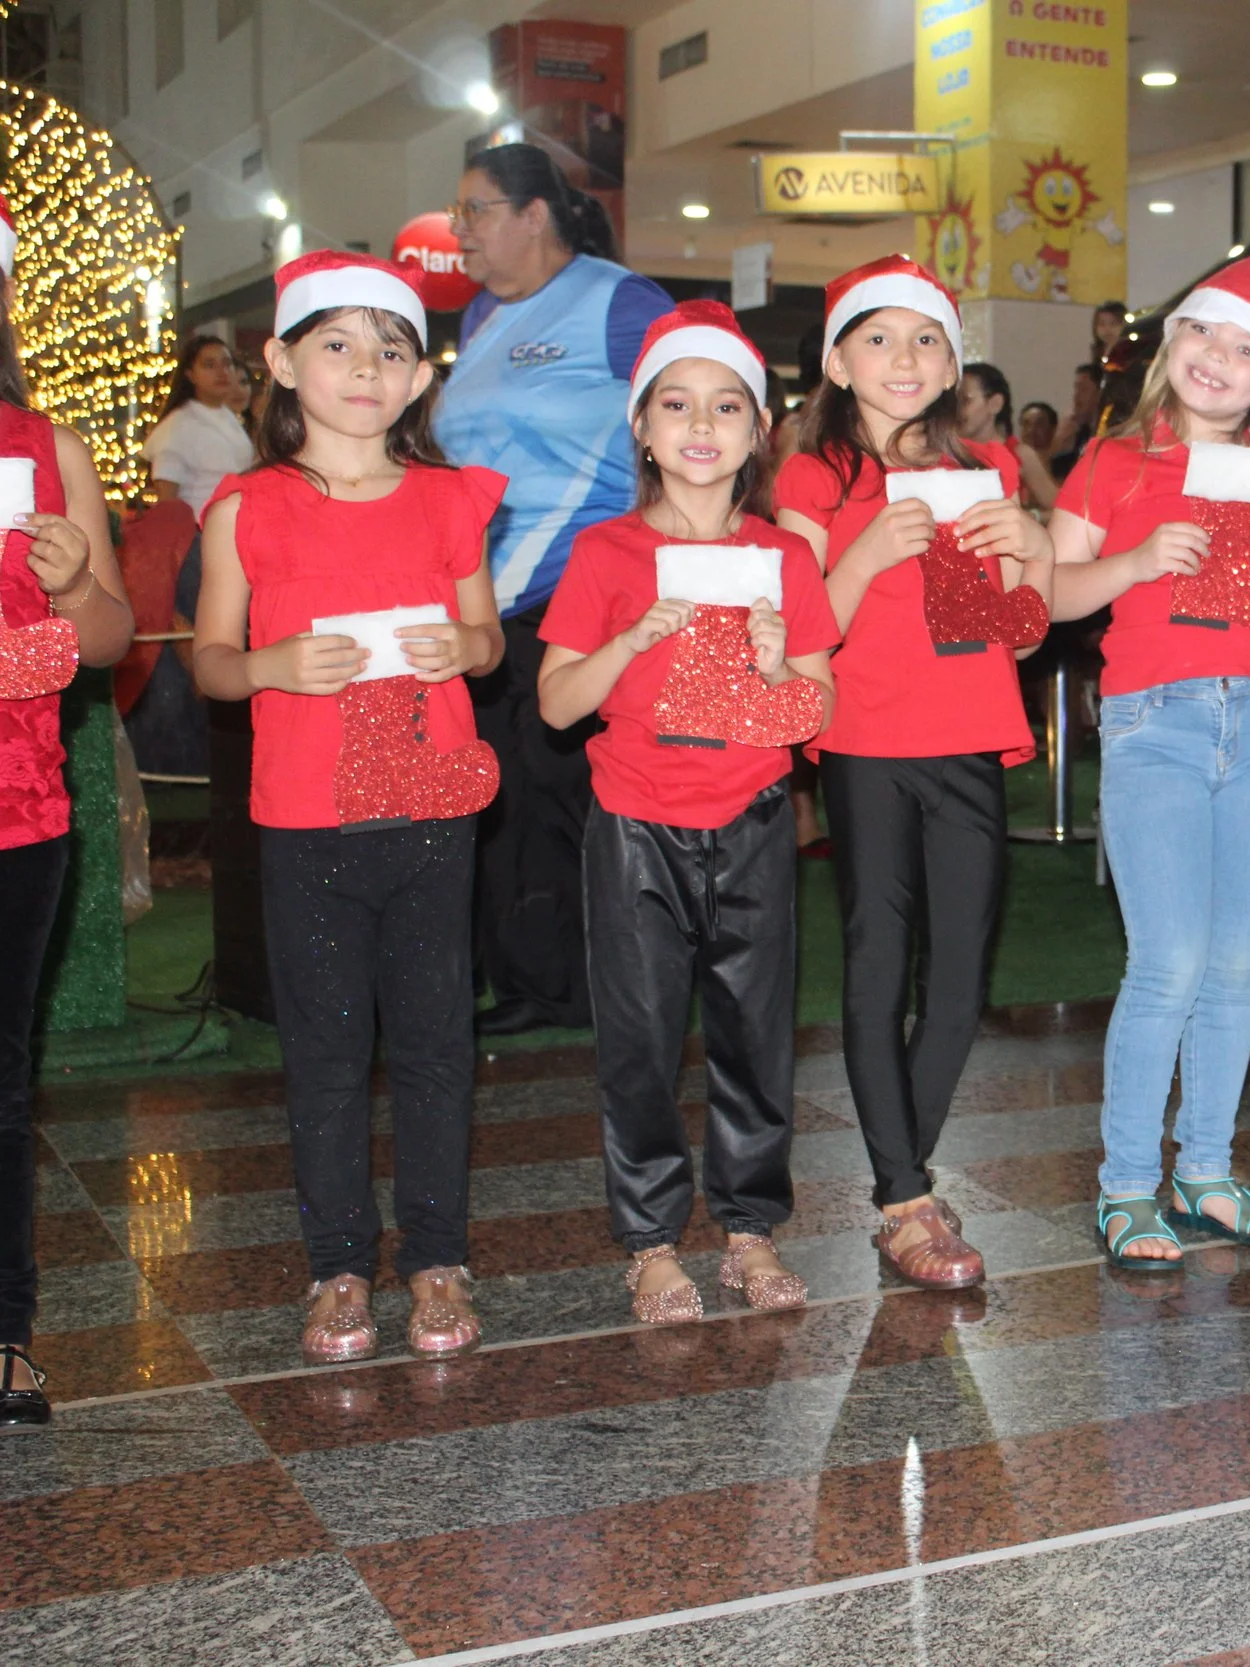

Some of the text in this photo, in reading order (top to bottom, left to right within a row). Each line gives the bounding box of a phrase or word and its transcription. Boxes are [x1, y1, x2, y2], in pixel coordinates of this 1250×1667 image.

[1033, 2, 1106, 27] GENTE
[1005, 40, 1109, 67] ENTENDE
[815, 171, 926, 195] AVENIDA
